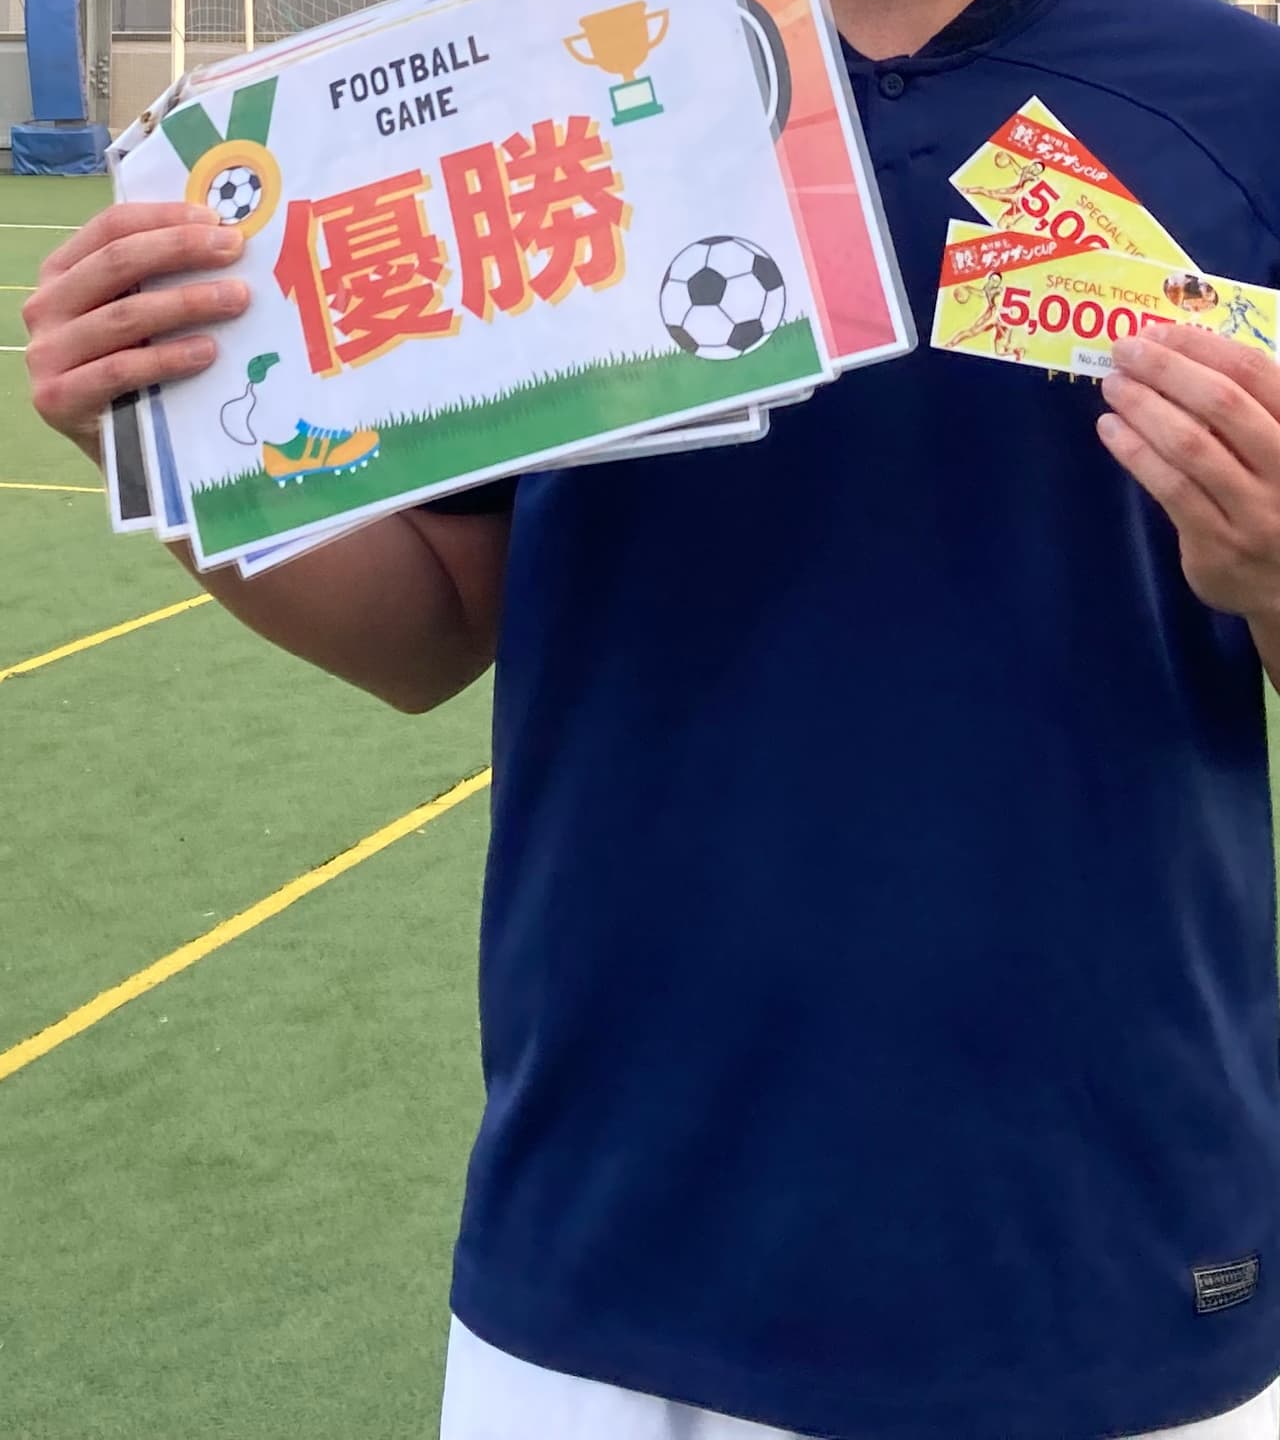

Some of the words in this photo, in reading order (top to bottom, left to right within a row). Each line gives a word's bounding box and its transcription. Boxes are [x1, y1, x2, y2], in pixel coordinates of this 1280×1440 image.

[329, 35, 490, 110] FOOTBALL
[375, 86, 458, 136] GAME
[1076, 194, 1124, 245] SPECIAL
[274, 115, 632, 378] 優勝
[1046, 274, 1107, 297] SPECIAL
[1109, 286, 1160, 309] TICKET
